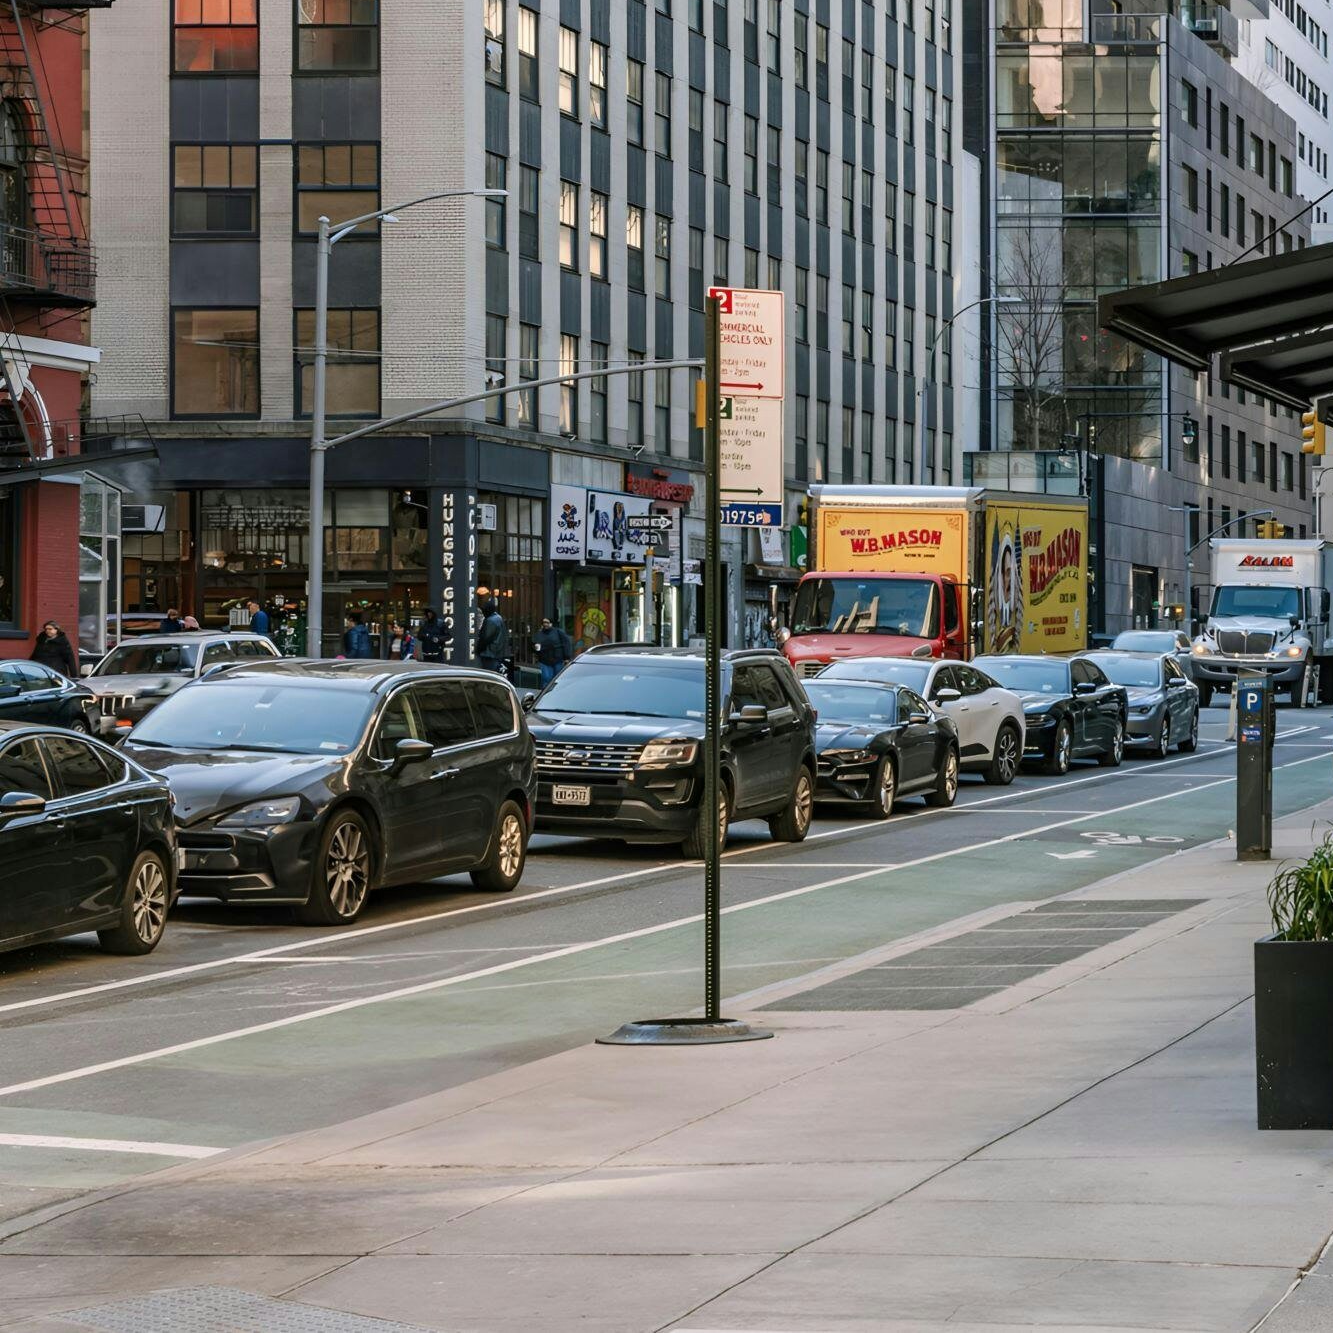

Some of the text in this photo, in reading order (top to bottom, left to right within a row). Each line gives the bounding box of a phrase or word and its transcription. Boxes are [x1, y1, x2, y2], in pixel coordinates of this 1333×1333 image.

[443, 493, 454, 581] HUNGRY
[468, 508, 476, 661] COFFEE
[1246, 692, 1258, 710] P
